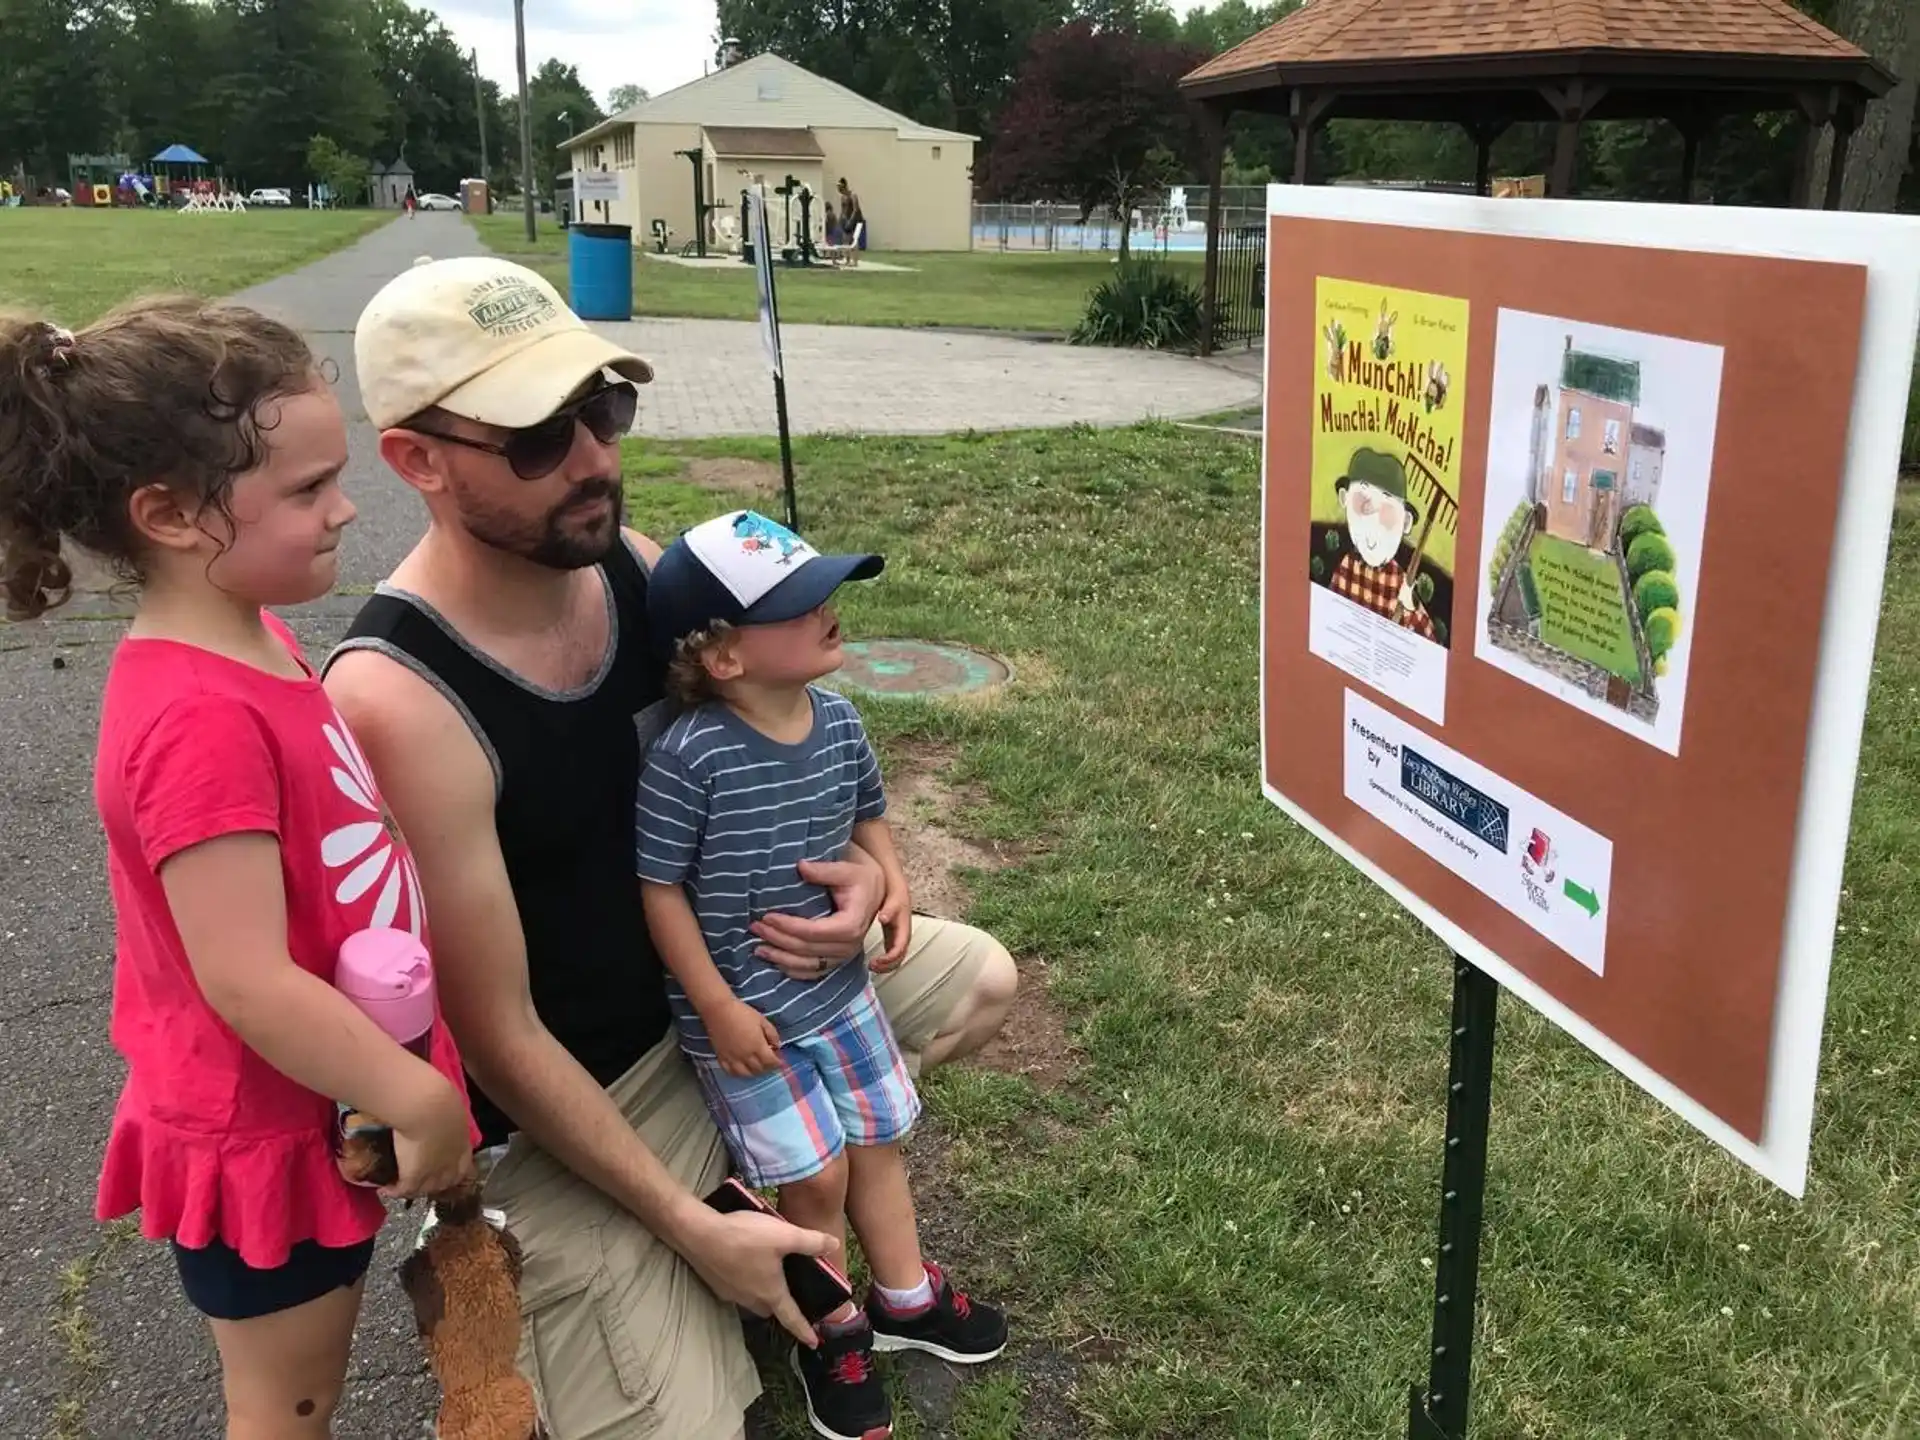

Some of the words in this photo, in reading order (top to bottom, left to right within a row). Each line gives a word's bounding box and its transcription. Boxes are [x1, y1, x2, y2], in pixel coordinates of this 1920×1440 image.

[1351, 718, 1399, 759] Presented
[1367, 747, 1381, 769] by
[1410, 772, 1468, 821] LIBRARY
